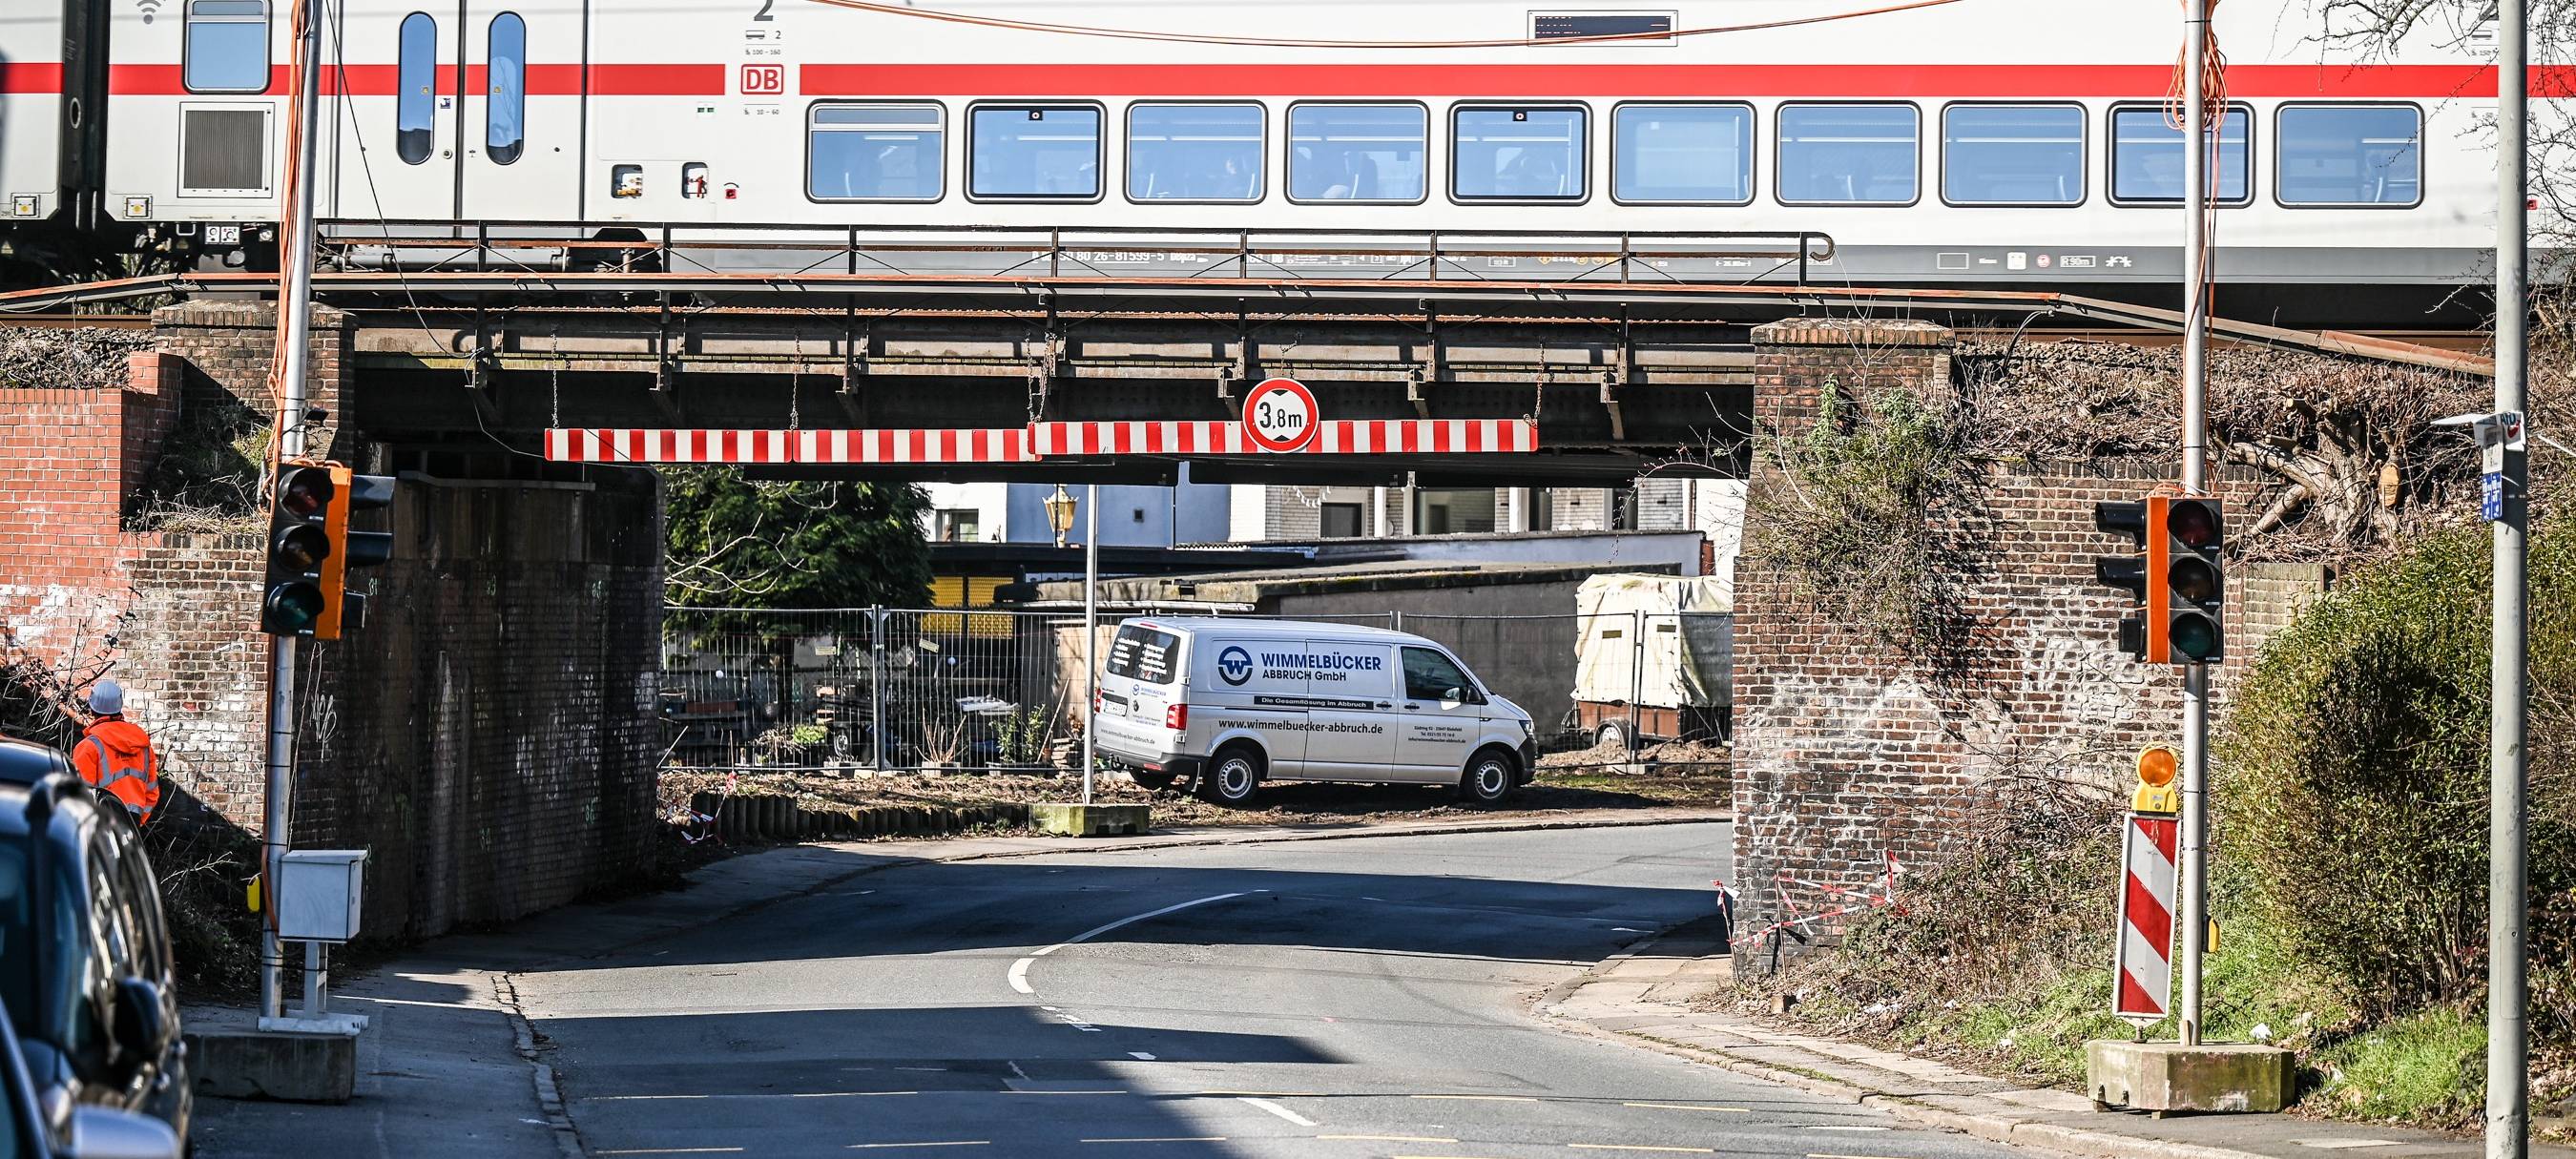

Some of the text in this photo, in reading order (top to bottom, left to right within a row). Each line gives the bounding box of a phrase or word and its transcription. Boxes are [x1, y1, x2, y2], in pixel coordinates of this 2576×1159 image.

[776, 30, 781, 39] 2
[746, 69, 779, 91] DB
[1260, 652, 1381, 671] WIMMELBÜCKER
[1262, 671, 1347, 681] ABBRUCH GmbH
[1275, 698, 1326, 707] Gesamtlösung
[1218, 719, 1383, 735] www.wimmelbuecker-abbruch.de
